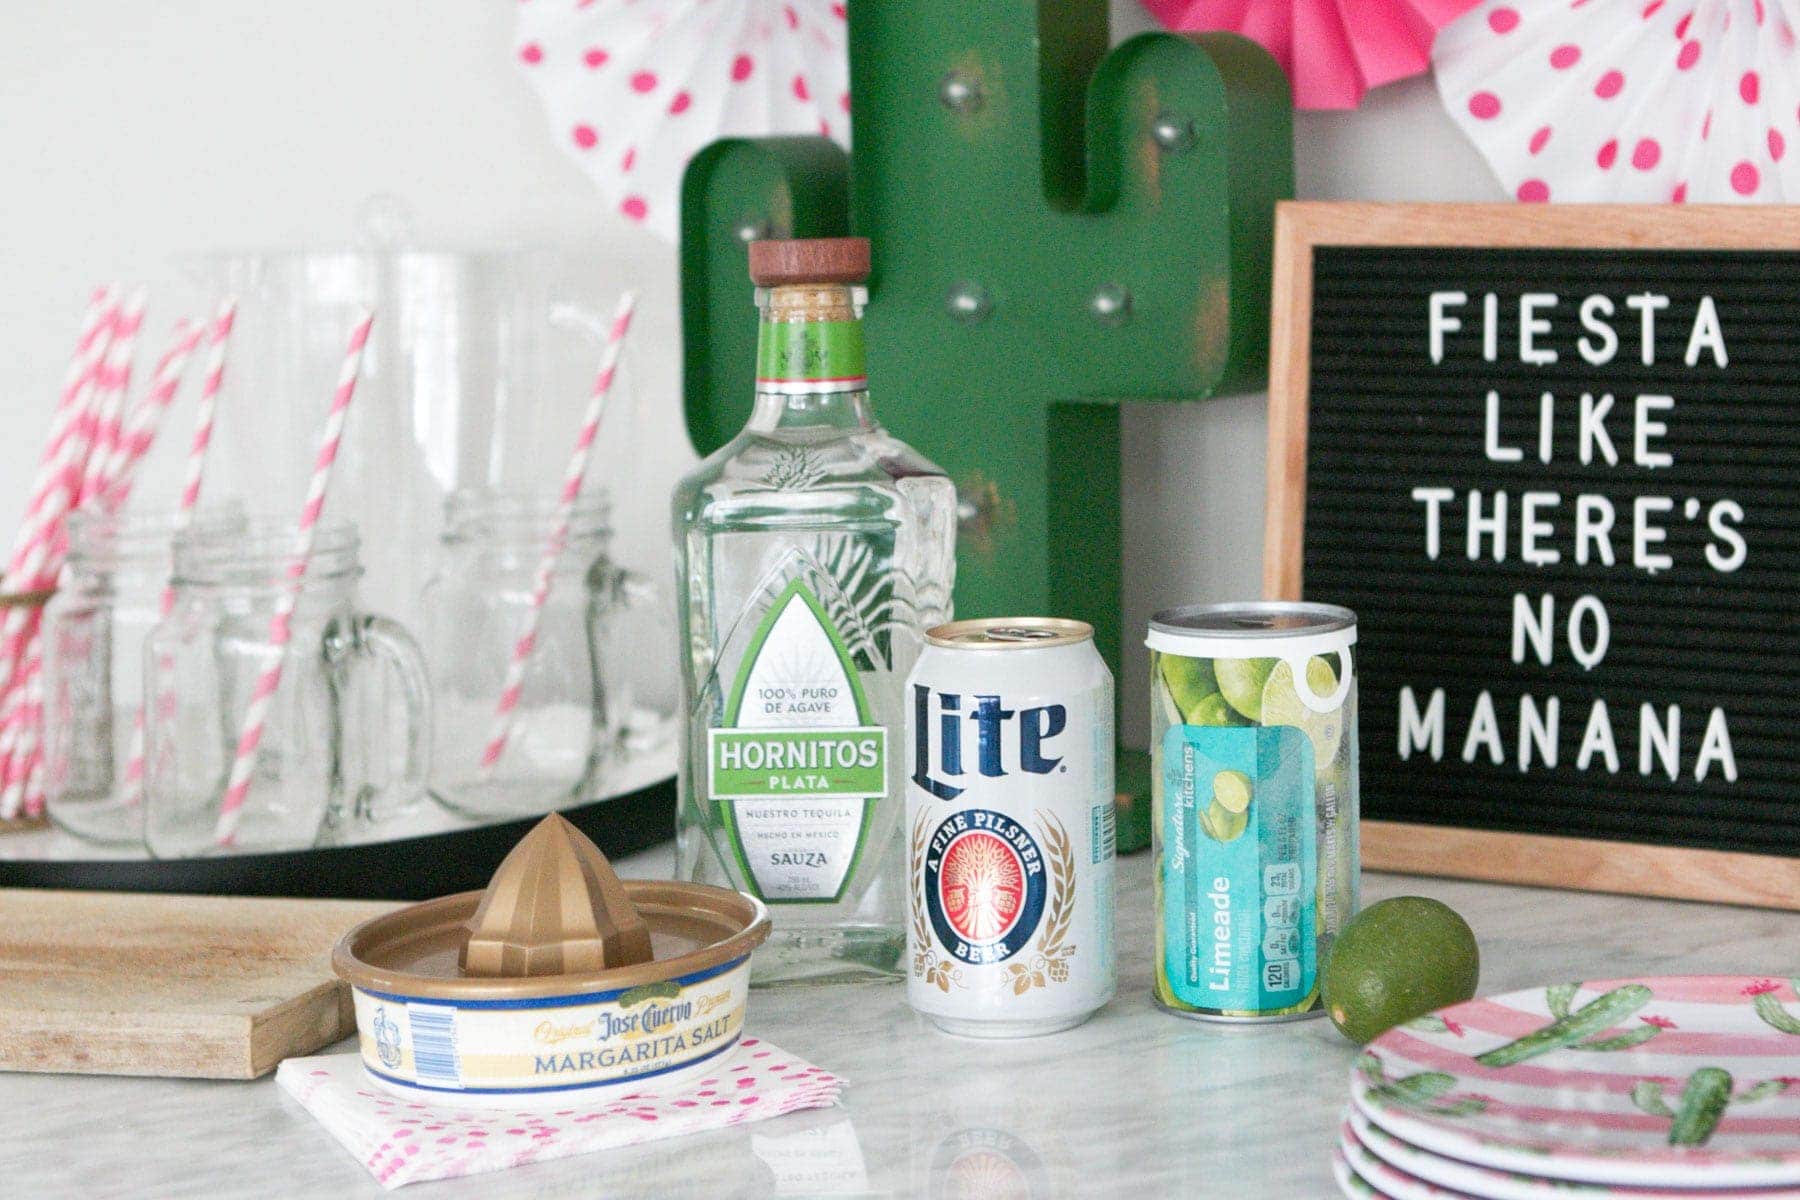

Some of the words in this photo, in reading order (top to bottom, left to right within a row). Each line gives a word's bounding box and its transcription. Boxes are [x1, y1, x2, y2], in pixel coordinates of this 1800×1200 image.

[1429, 291, 1728, 369] FIESTA
[1485, 390, 1675, 468] LIKE
[1411, 487, 1748, 574] THERE'S
[1511, 593, 1610, 670] NO
[758, 688, 796, 700] 100%
[802, 687, 838, 699] PURO
[765, 702, 782, 713] DE
[788, 702, 831, 713] AGAVE
[910, 683, 1067, 801] Lite
[1398, 685, 1738, 782] MANANA
[720, 739, 878, 770] HORNITOS
[768, 775, 830, 790] PLATA
[1182, 746, 1195, 808] kitchens
[746, 809, 798, 819] NUESTRO
[803, 808, 851, 818] TEQUILA
[933, 814, 968, 854] FINE
[1170, 791, 1191, 874] Signature
[771, 852, 828, 868] SAUZA
[973, 811, 1041, 877] PILSNER
[928, 859, 939, 873] A
[953, 941, 1012, 964] BEER
[1189, 912, 1198, 955] Guaranteed
[1206, 876, 1231, 992] Limeade
[1189, 955, 1198, 983] Quality
[1268, 965, 1282, 988] 120
[597, 1011, 639, 1042] Jose
[642, 1002, 691, 1034] Cuervo
[534, 1035, 687, 1074] MARGARITA
[691, 1014, 731, 1046] SALT
